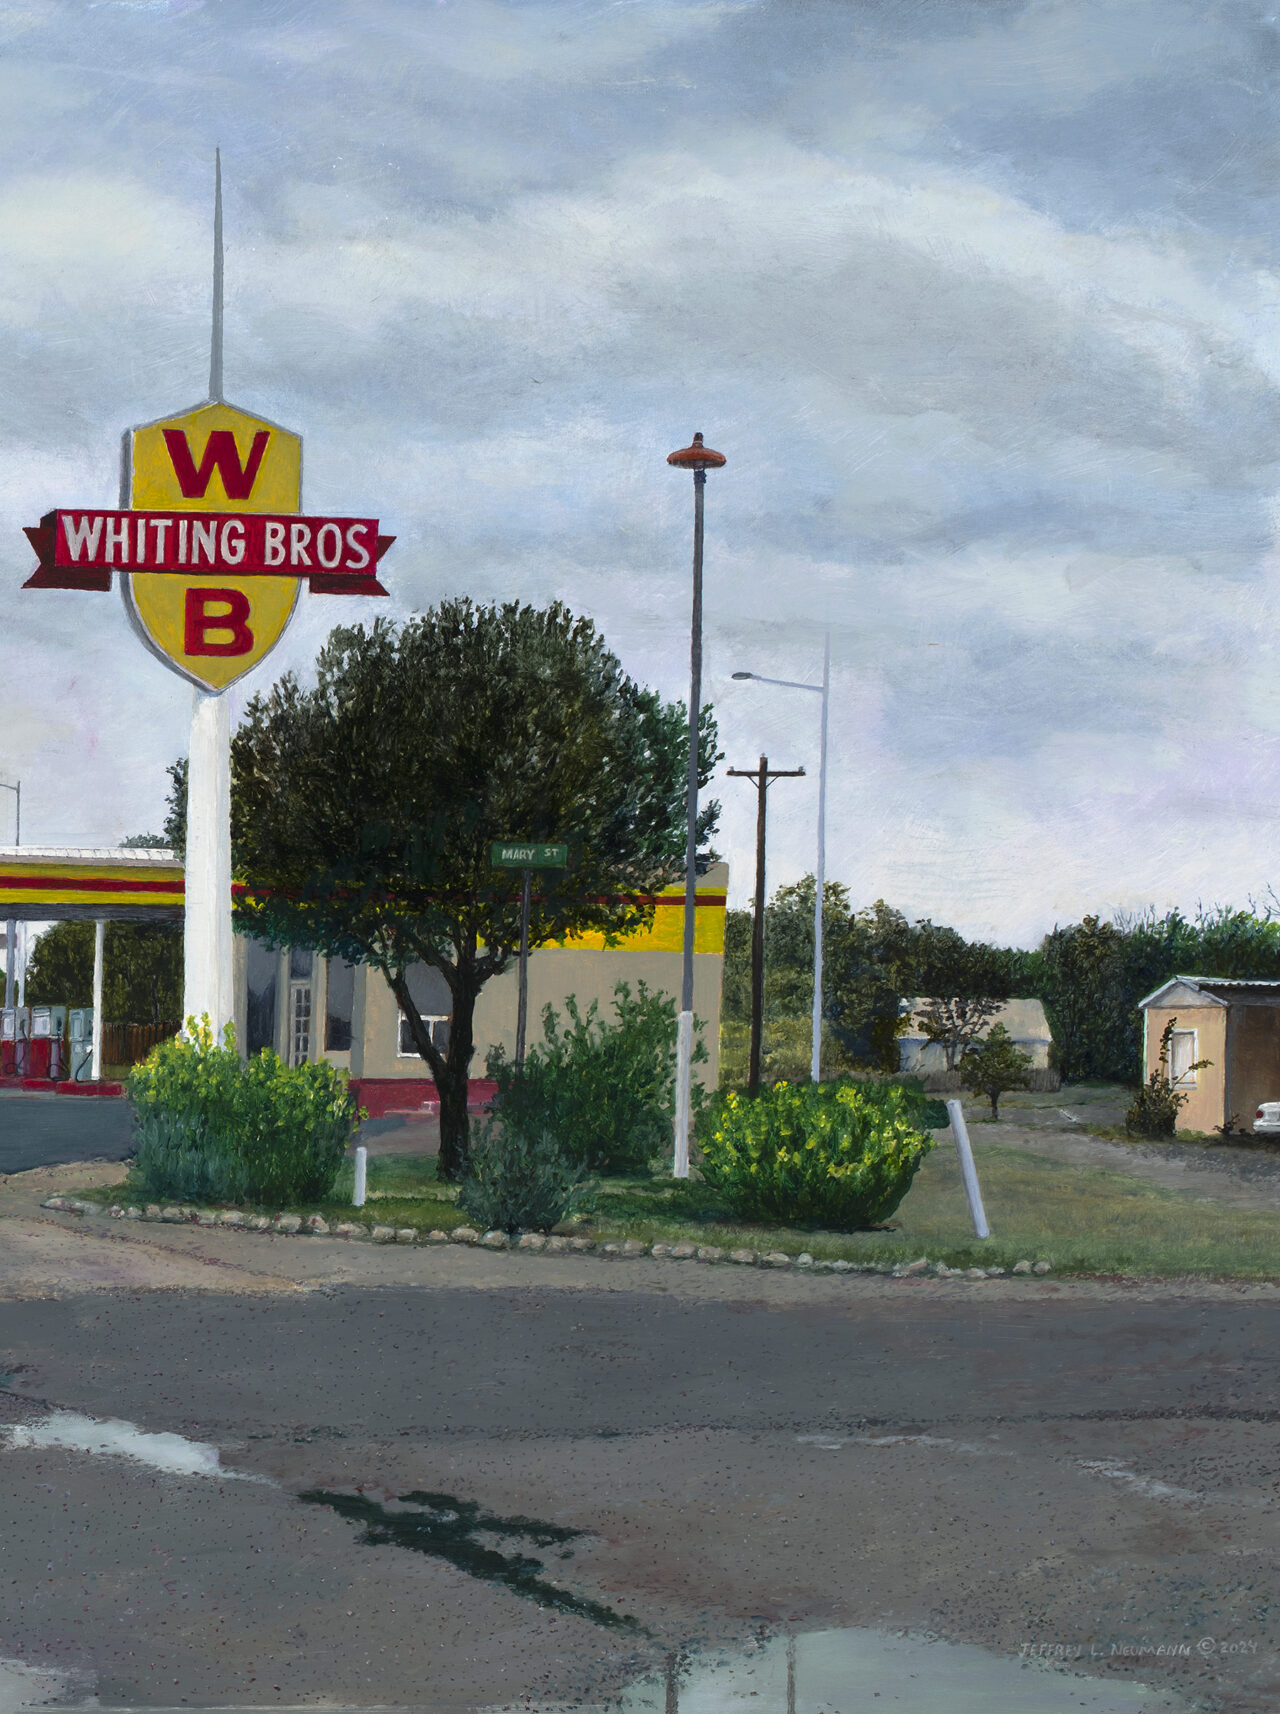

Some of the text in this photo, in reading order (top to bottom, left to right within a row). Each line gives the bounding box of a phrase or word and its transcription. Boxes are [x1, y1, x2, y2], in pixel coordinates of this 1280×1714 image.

[162, 429, 270, 500] W
[61, 515, 372, 569] WHITING BROS
[184, 588, 254, 656] B
[501, 848, 559, 860] MARY ST
[1018, 1642, 1082, 1657] JEFFREY
[1090, 1643, 1104, 1656] L.
[1110, 1643, 1192, 1657] NEUMANN
